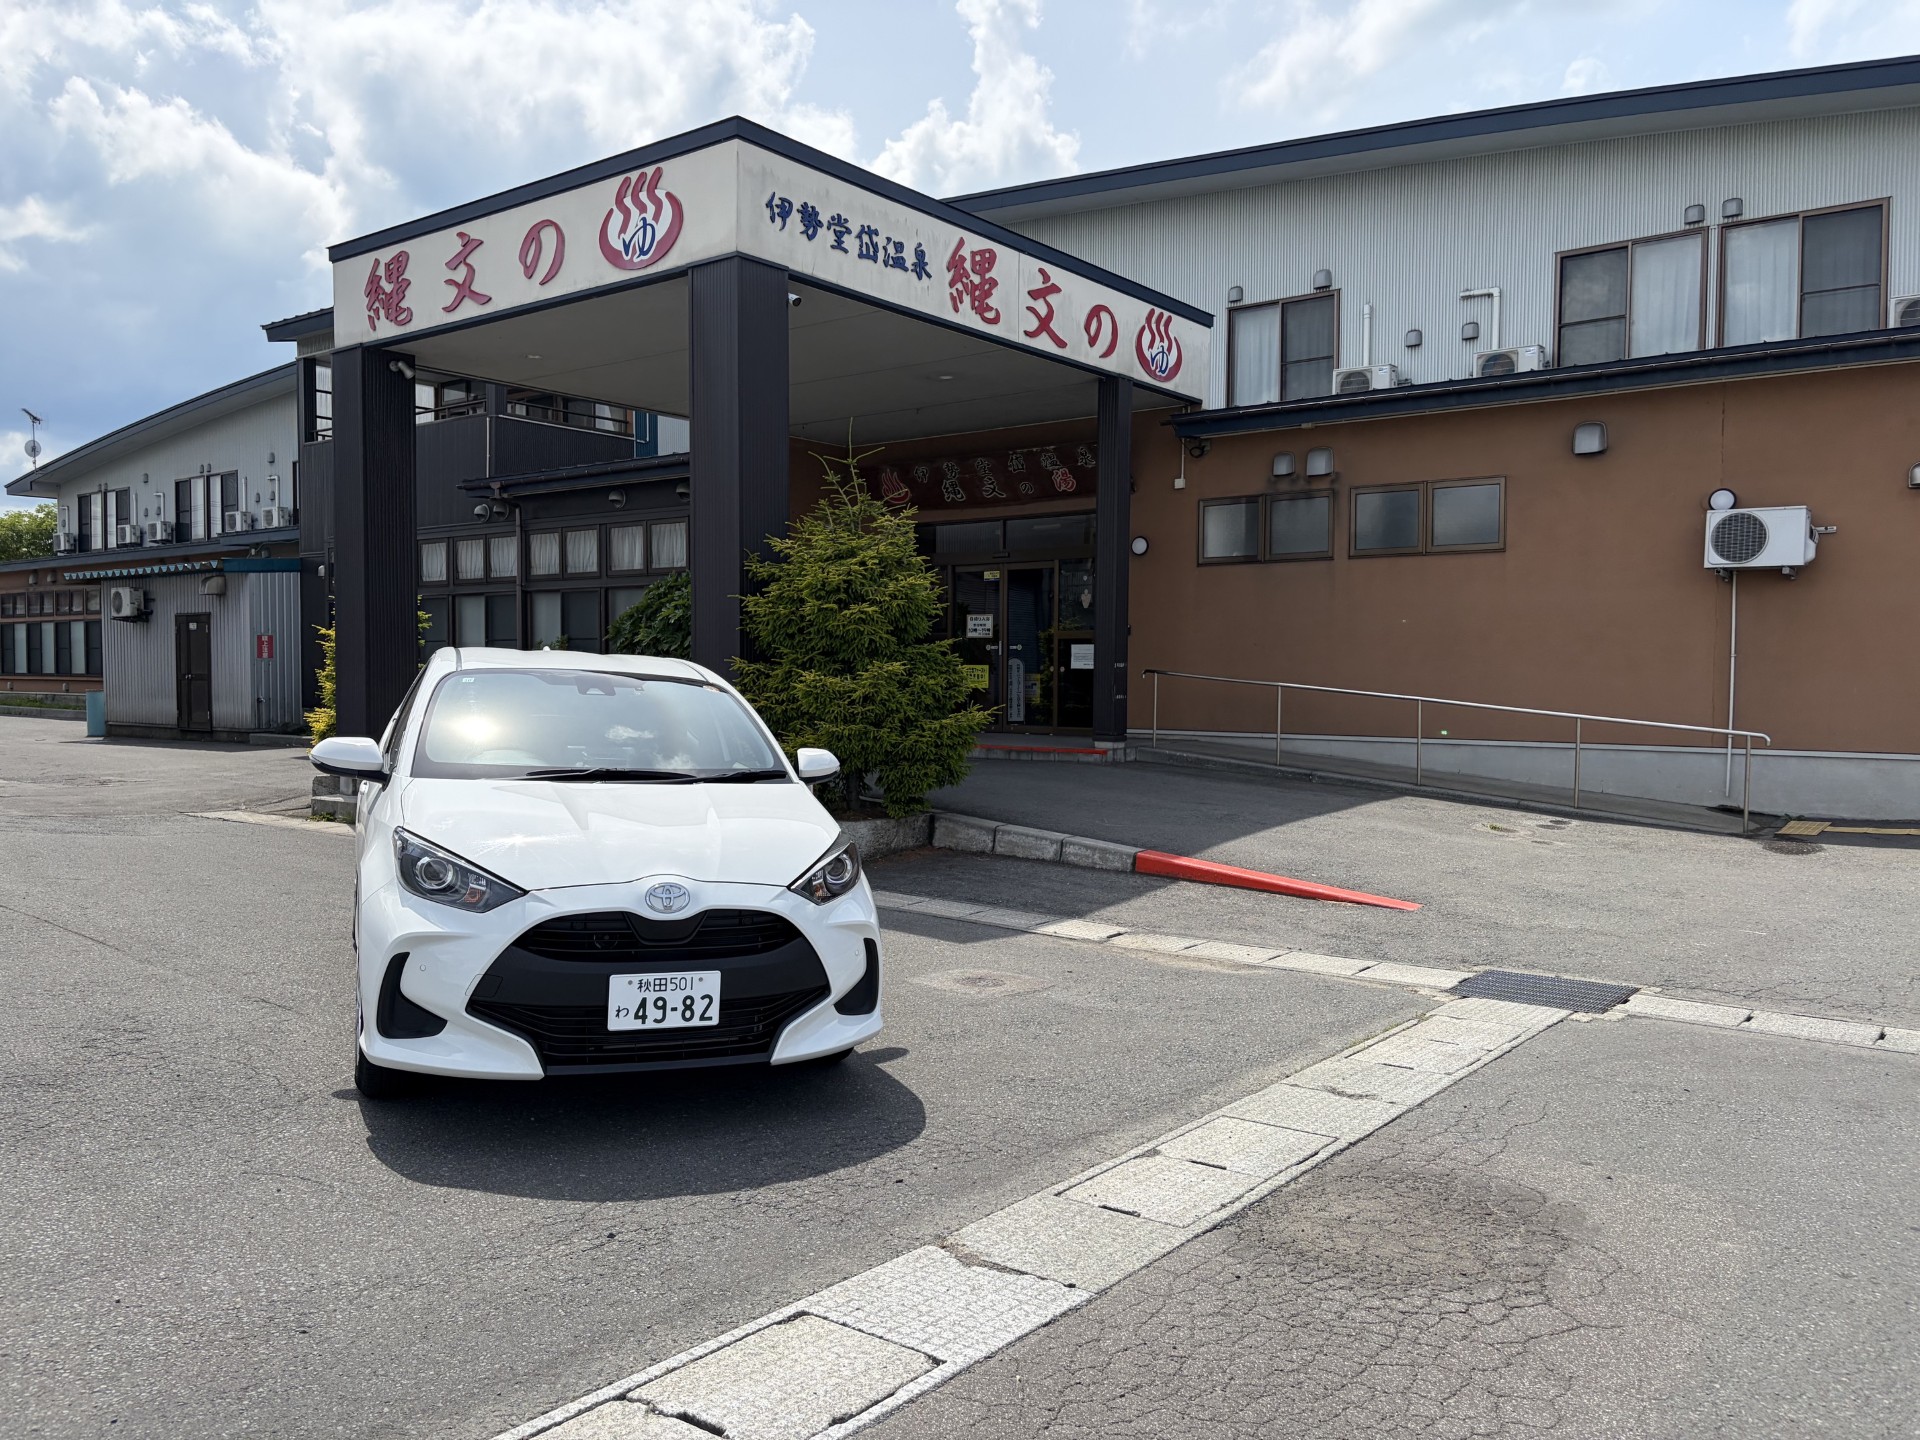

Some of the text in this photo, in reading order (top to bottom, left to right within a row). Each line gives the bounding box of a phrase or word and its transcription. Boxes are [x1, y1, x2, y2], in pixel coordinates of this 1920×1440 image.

[765, 191, 932, 281] 伊勢堂岱温泉
[633, 994, 714, 1024] 49-82
